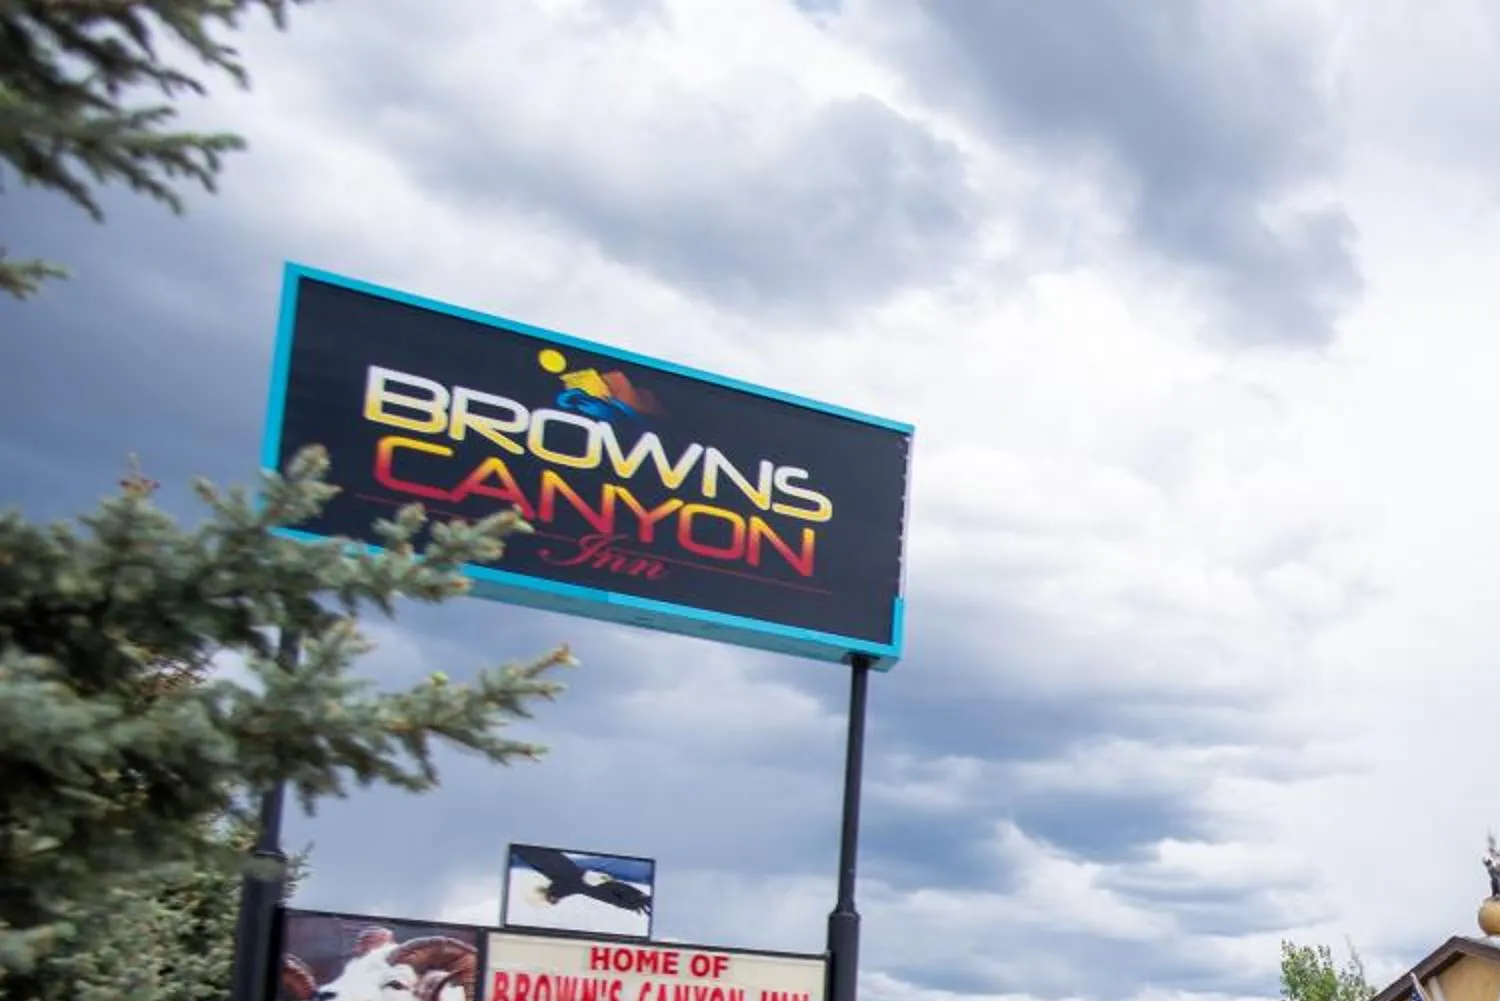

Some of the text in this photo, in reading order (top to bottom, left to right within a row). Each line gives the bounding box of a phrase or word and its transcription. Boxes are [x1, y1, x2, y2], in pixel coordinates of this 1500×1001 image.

[362, 365, 833, 522] BROWNS
[373, 435, 815, 577] CANYON
[538, 532, 669, 581] Inn
[591, 946, 730, 978] HOME OF
